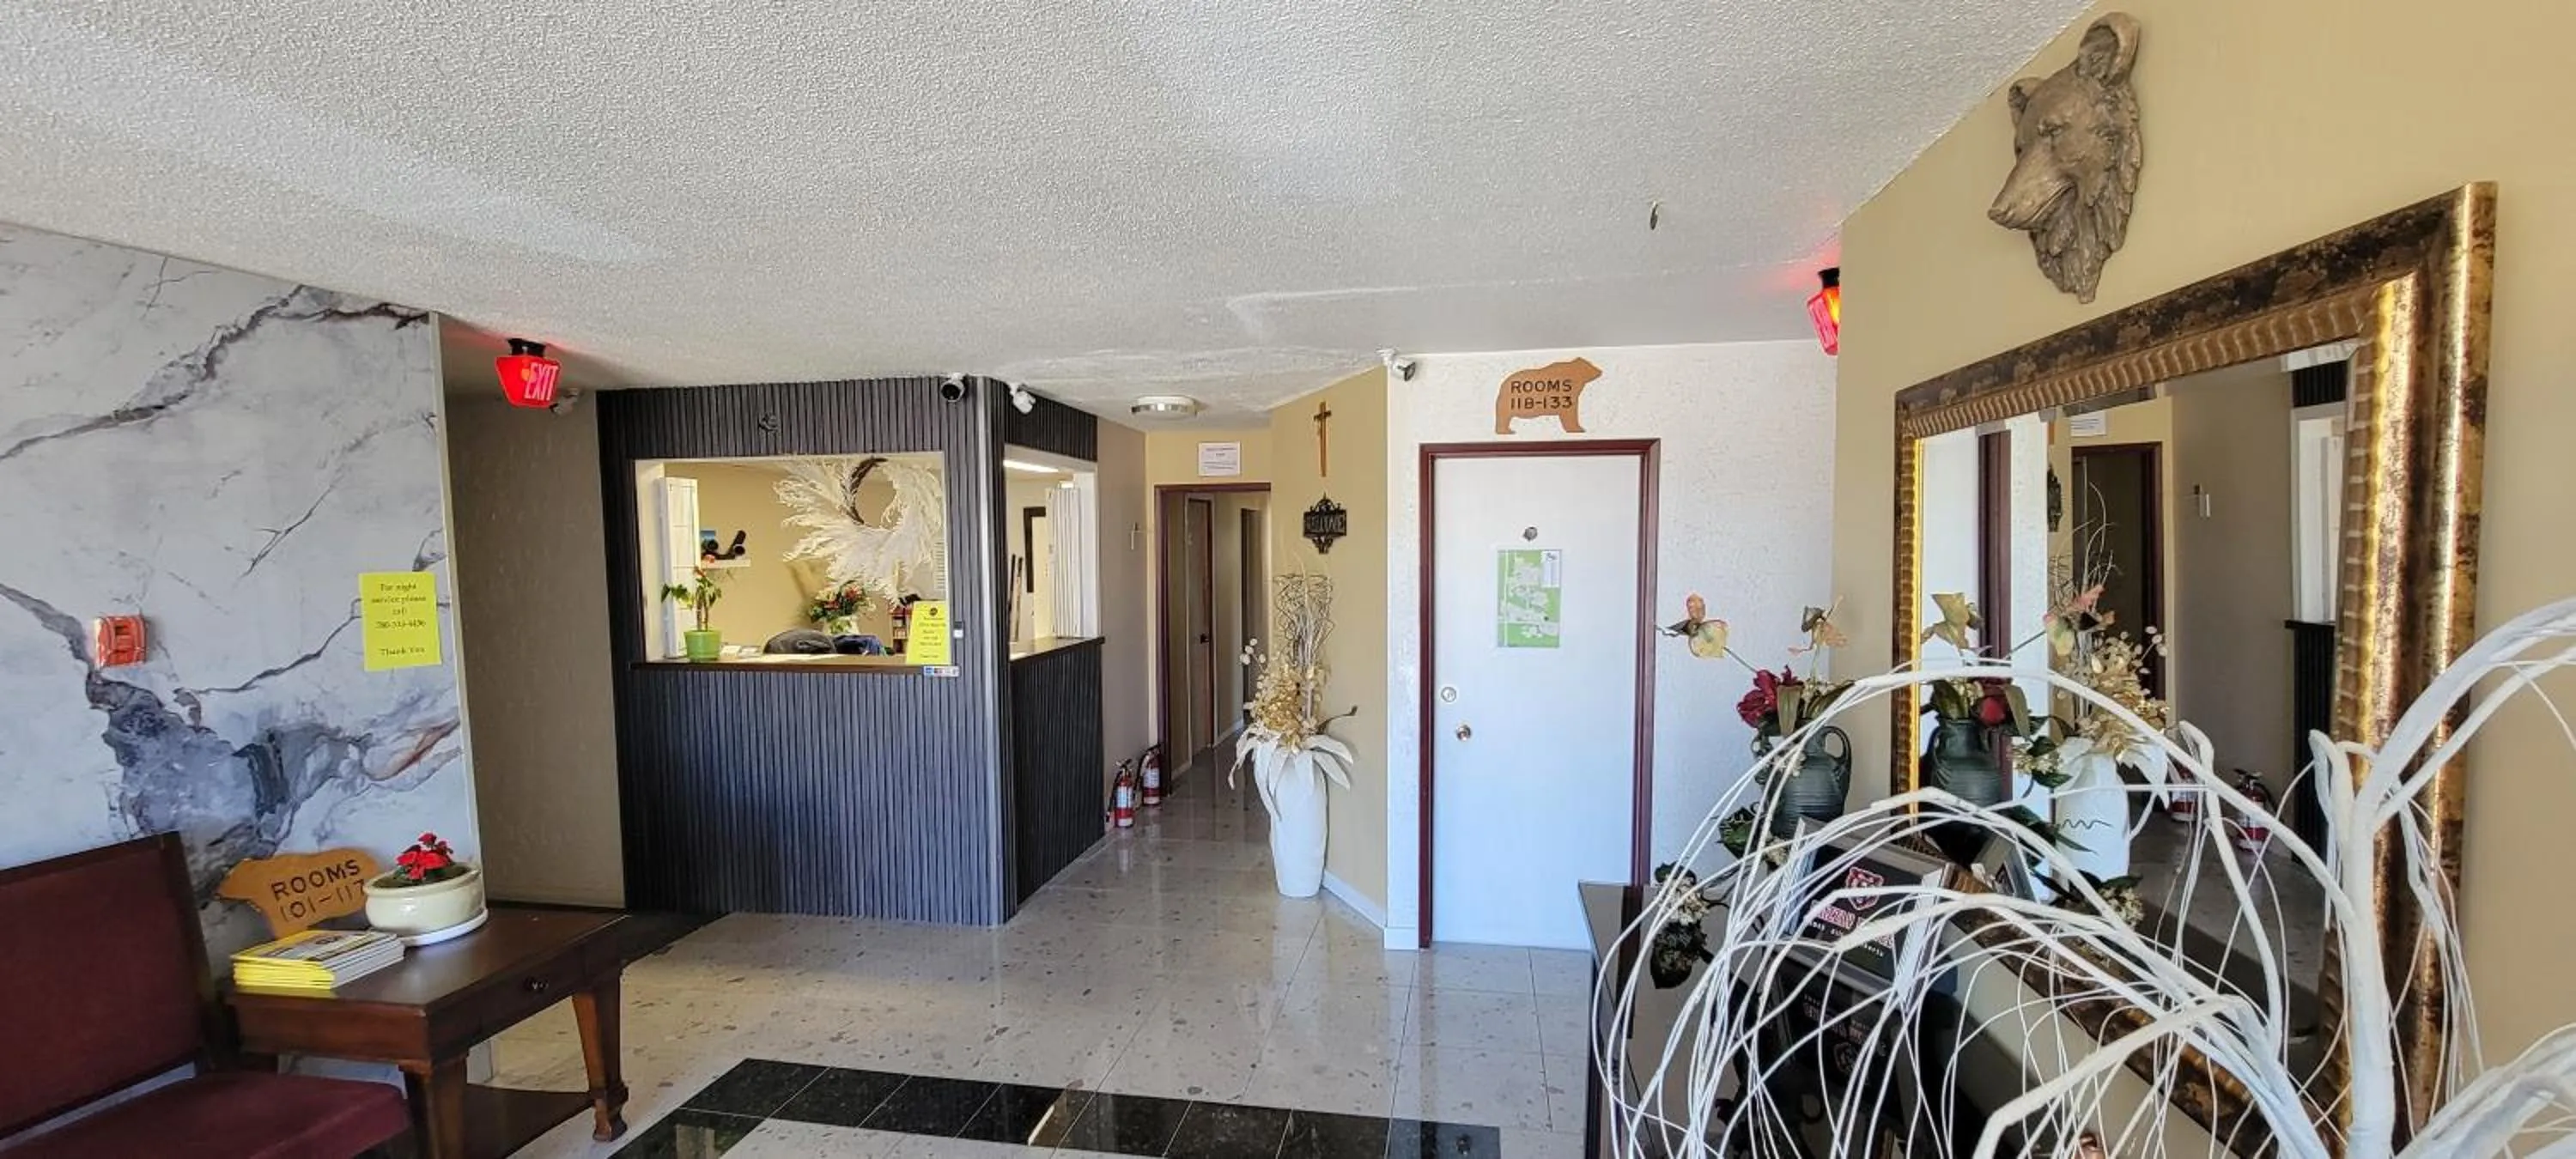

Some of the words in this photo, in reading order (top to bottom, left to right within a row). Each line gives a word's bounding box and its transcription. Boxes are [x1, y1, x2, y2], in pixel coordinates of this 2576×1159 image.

[524, 361, 558, 401] EXIT
[1510, 379, 1573, 394] ROOMS
[1510, 396, 1573, 410] 118-133
[270, 859, 361, 901] ROOMS
[280, 878, 366, 923] 101-117
